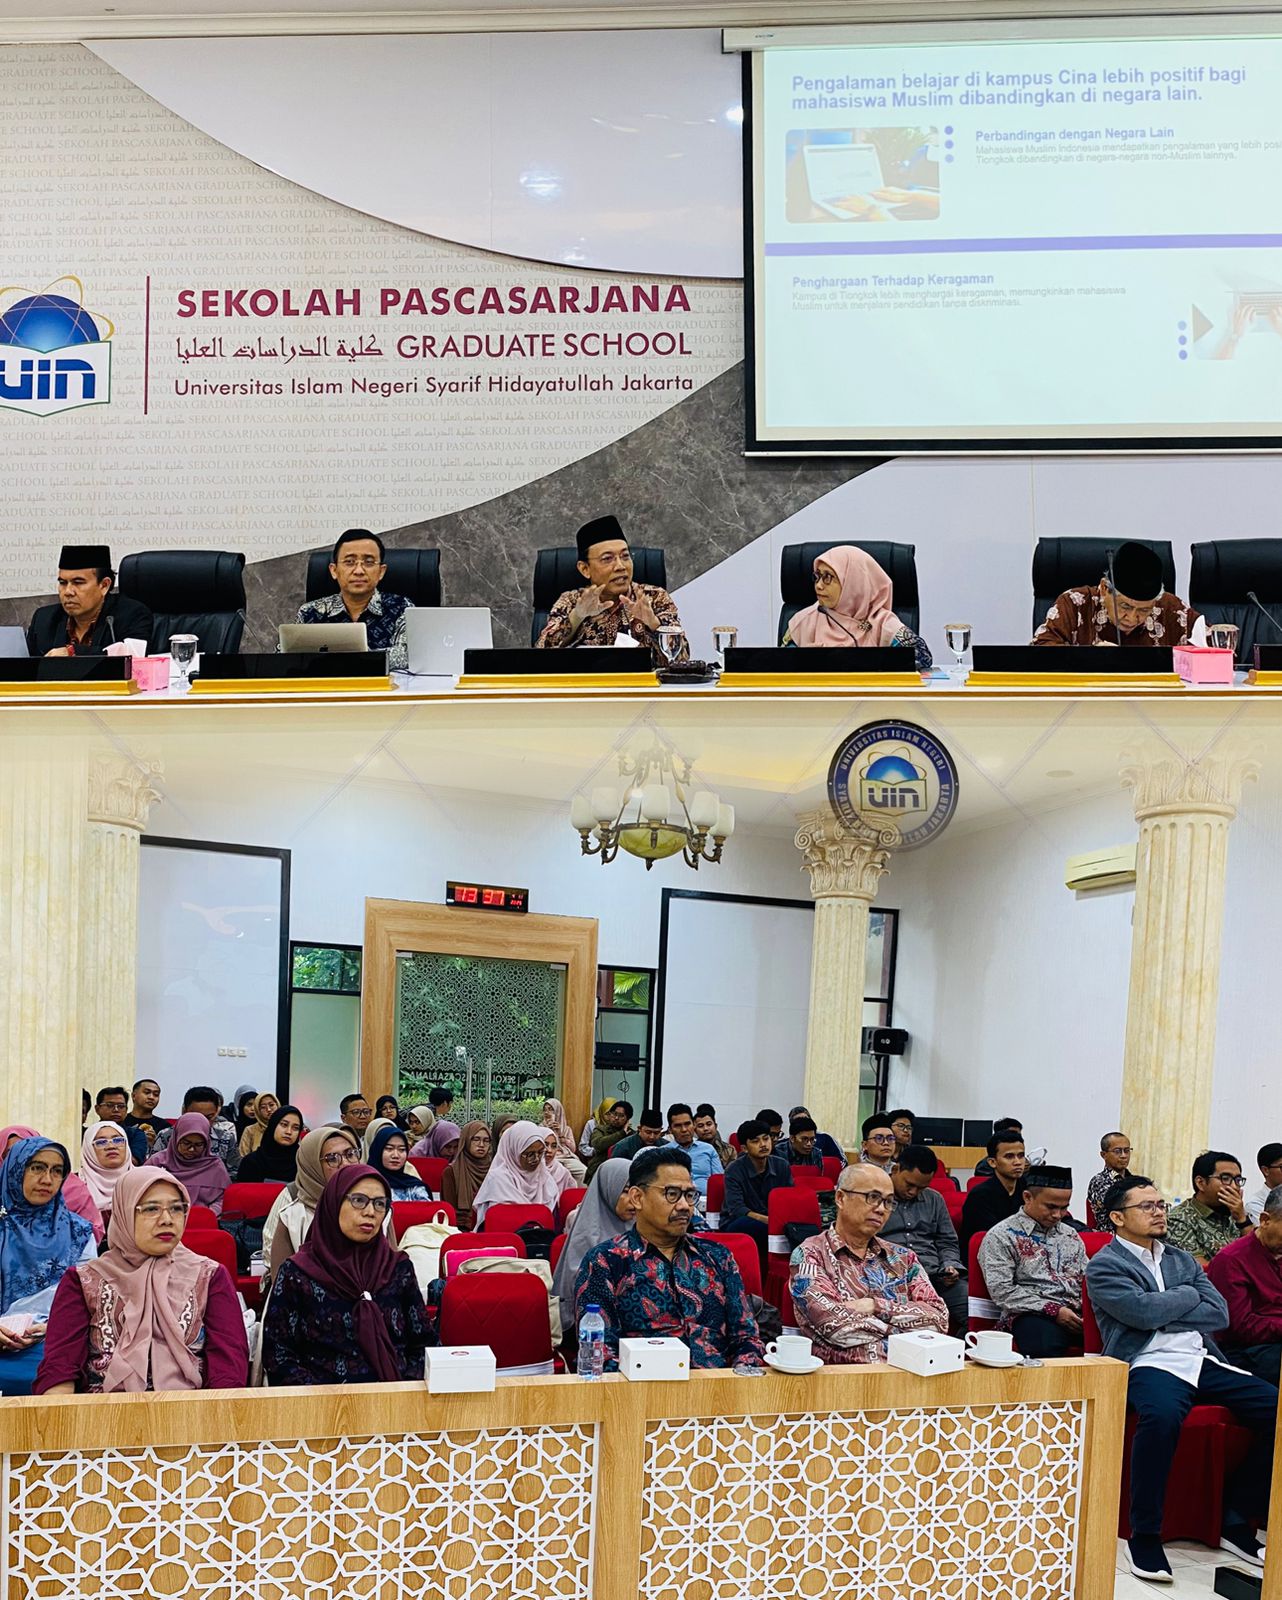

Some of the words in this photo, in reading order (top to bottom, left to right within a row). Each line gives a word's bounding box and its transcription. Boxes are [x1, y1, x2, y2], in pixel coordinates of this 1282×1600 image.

[792, 76, 896, 93] Pengalaman
[902, 73, 959, 91] belajar
[965, 72, 980, 87] di
[986, 71, 1053, 88] kampus
[1058, 70, 1097, 84] Cina
[1102, 68, 1144, 84] lebih
[1150, 67, 1205, 86] positif
[1209, 66, 1246, 84] bagi
[792, 94, 887, 110] mahasiswa
[892, 90, 953, 107] Muslim
[959, 88, 1076, 106] dibandingkan
[1081, 88, 1097, 103] di
[1102, 89, 1161, 105] negara
[1167, 86, 1202, 101] lain.
[976, 130, 1056, 142] Perbandingan
[1058, 129, 1101, 142] dengan
[1105, 128, 1146, 140] Negara
[1150, 127, 1174, 138] Lain
[792, 276, 868, 290] Penghargaan
[872, 276, 924, 288] Terhadap
[928, 274, 994, 286] Keragaman
[177, 288, 361, 318] SEKOLAH
[380, 284, 692, 316] PASCASARJANA
[176, 336, 226, 364] العليا
[232, 334, 330, 365] الدراسات
[336, 334, 384, 364] كلية
[396, 334, 555, 358] GRADUATE
[563, 332, 692, 356] SCHOOL
[175, 379, 283, 396] Universitas
[291, 378, 344, 394] Islam
[352, 376, 418, 398] Negeri
[426, 375, 481, 397] Syarif
[488, 374, 614, 396] Hidayatullah
[621, 373, 693, 392] Jakarta
[840, 730, 888, 770] UNIVERSITAS
[891, 729, 920, 744] ISLAM
[920, 740, 946, 770] NEGERI
[930, 784, 950, 830] JAKARTA
[482, 888, 505, 906] 37
